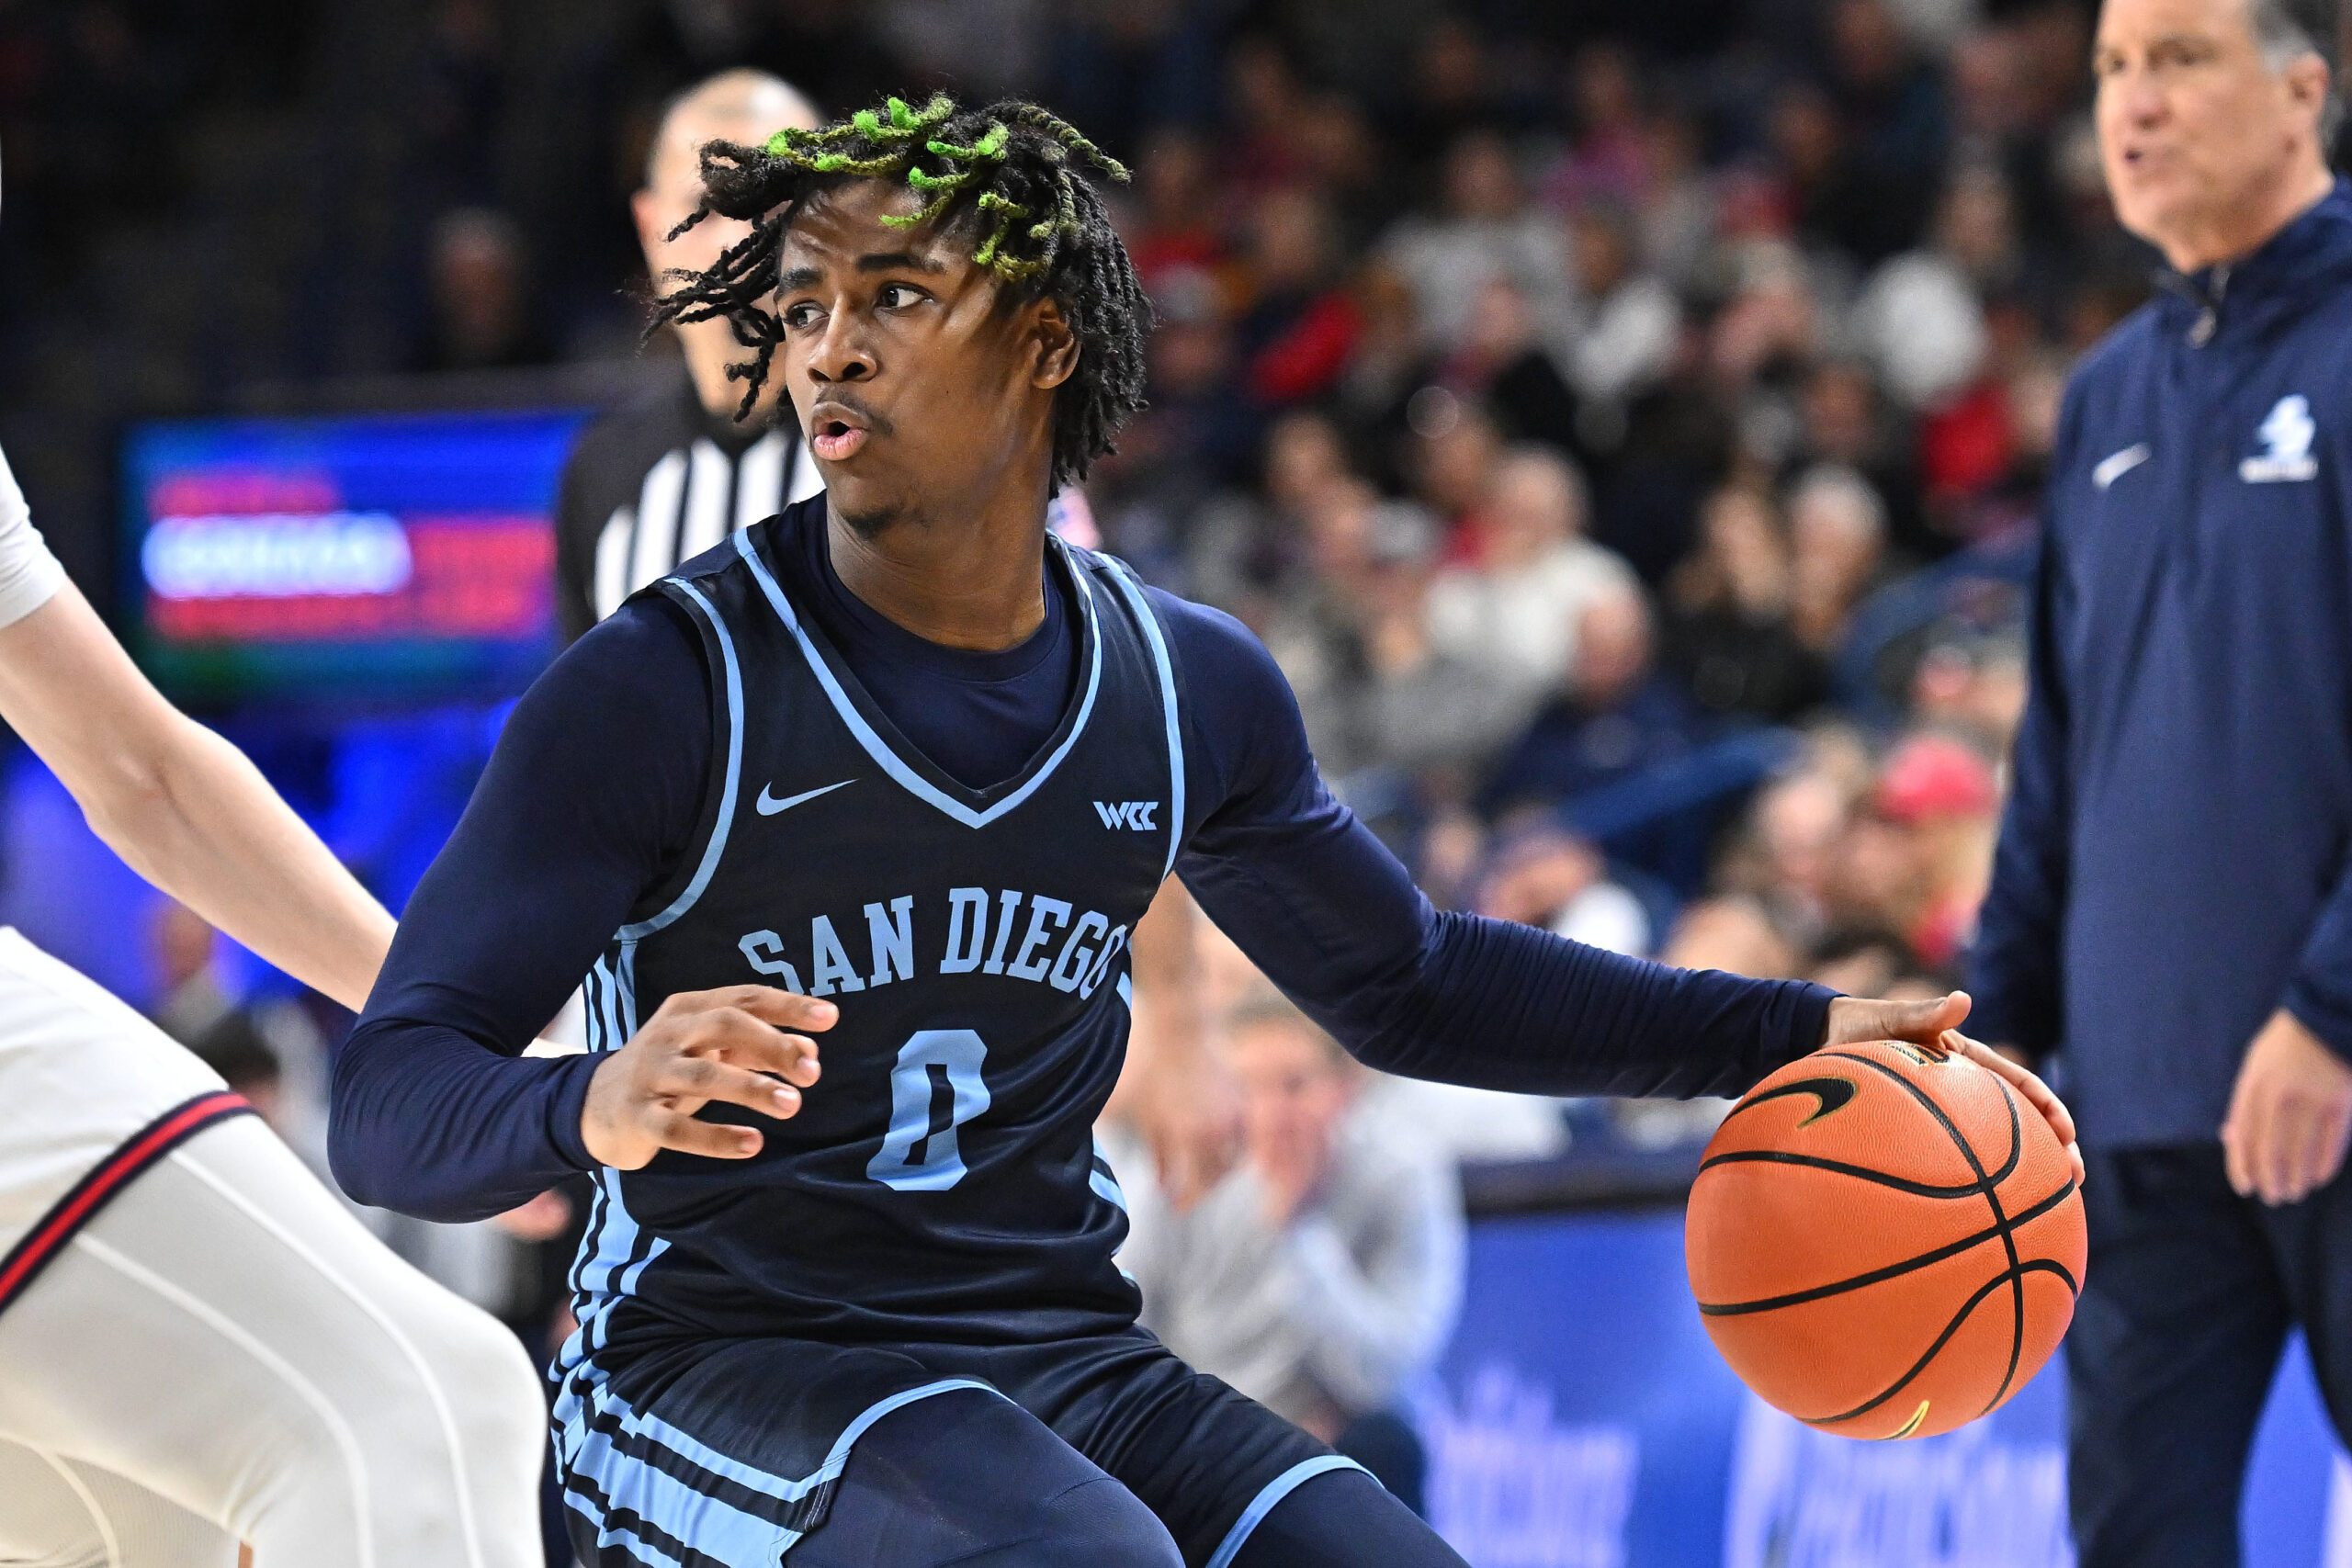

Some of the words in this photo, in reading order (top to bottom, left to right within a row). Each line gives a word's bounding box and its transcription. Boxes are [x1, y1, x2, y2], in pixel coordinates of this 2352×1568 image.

[1092, 801, 1159, 831] WCC
[738, 895, 914, 998] SAN
[940, 886, 1127, 1000] DIEGO
[866, 1029, 991, 1191] 0
